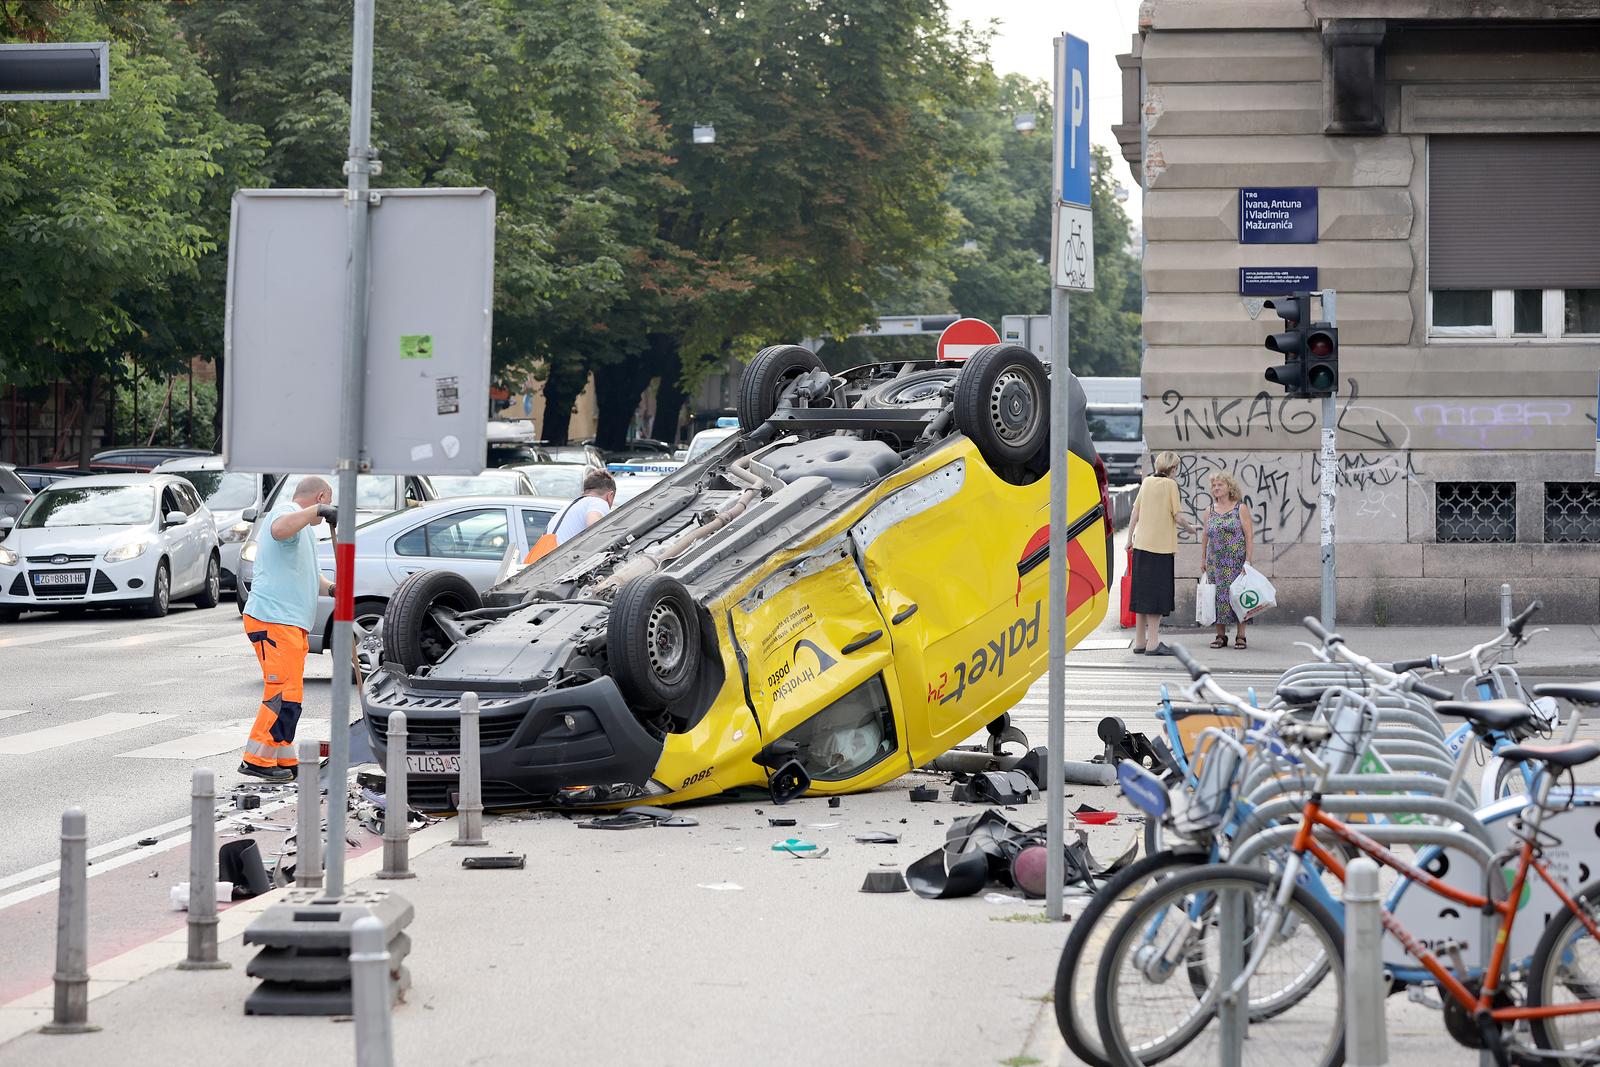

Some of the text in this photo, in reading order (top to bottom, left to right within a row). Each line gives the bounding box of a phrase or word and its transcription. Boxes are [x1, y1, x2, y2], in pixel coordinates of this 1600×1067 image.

[1070, 67, 1084, 169] P
[1245, 200, 1302, 209] Ivana, Antuna
[1245, 210, 1290, 219] i Vladimira
[1245, 220, 1293, 230] Mažuranića
[40, 575, 50, 584] ZG
[928, 600, 1041, 705] Paket 24
[767, 660, 790, 687] pošta
[772, 667, 815, 702] Hrvatska
